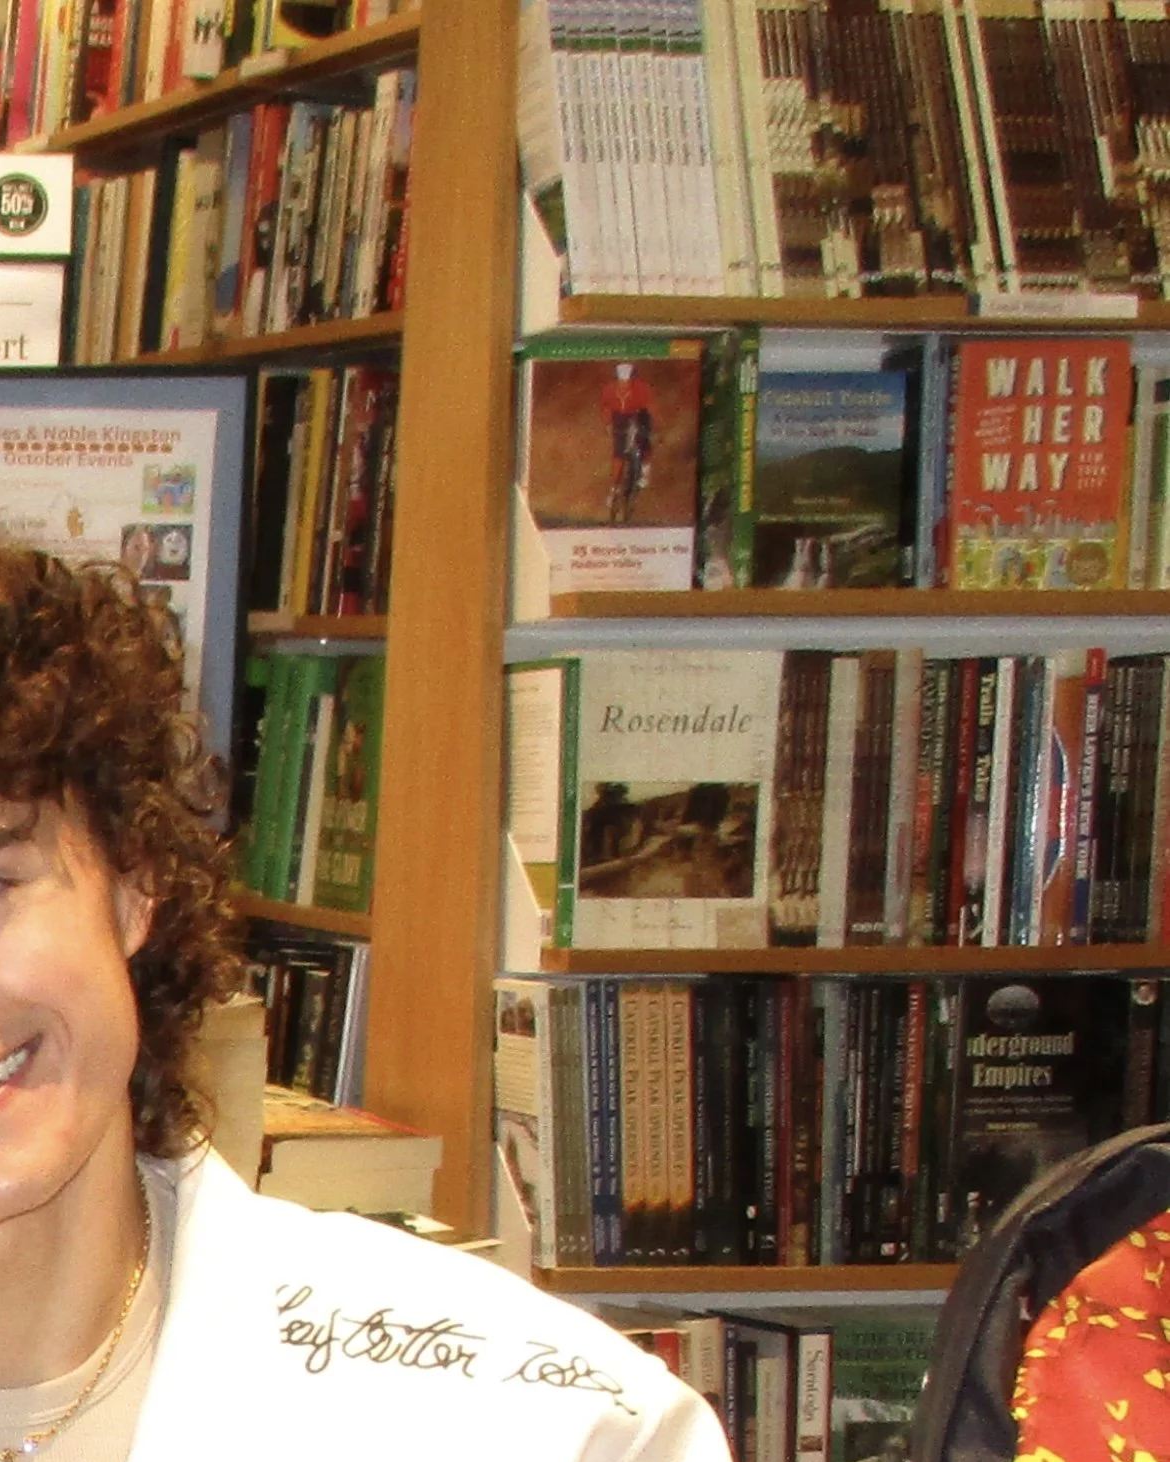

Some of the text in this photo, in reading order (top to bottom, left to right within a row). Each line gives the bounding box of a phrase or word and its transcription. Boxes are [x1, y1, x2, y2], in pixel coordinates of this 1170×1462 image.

[985, 356, 1109, 399] WALK
[43, 425, 97, 441] Noble
[101, 426, 181, 444] Kingston
[1021, 403, 1104, 444] HER
[3, 452, 134, 467] October Events
[981, 452, 1070, 493] WAY
[598, 703, 753, 734] Rosendale
[974, 672, 997, 802] Trails Tales
[1079, 800, 1092, 837] NEW
[1076, 839, 1090, 880] YORK
[972, 1063, 1053, 1089] Empires
